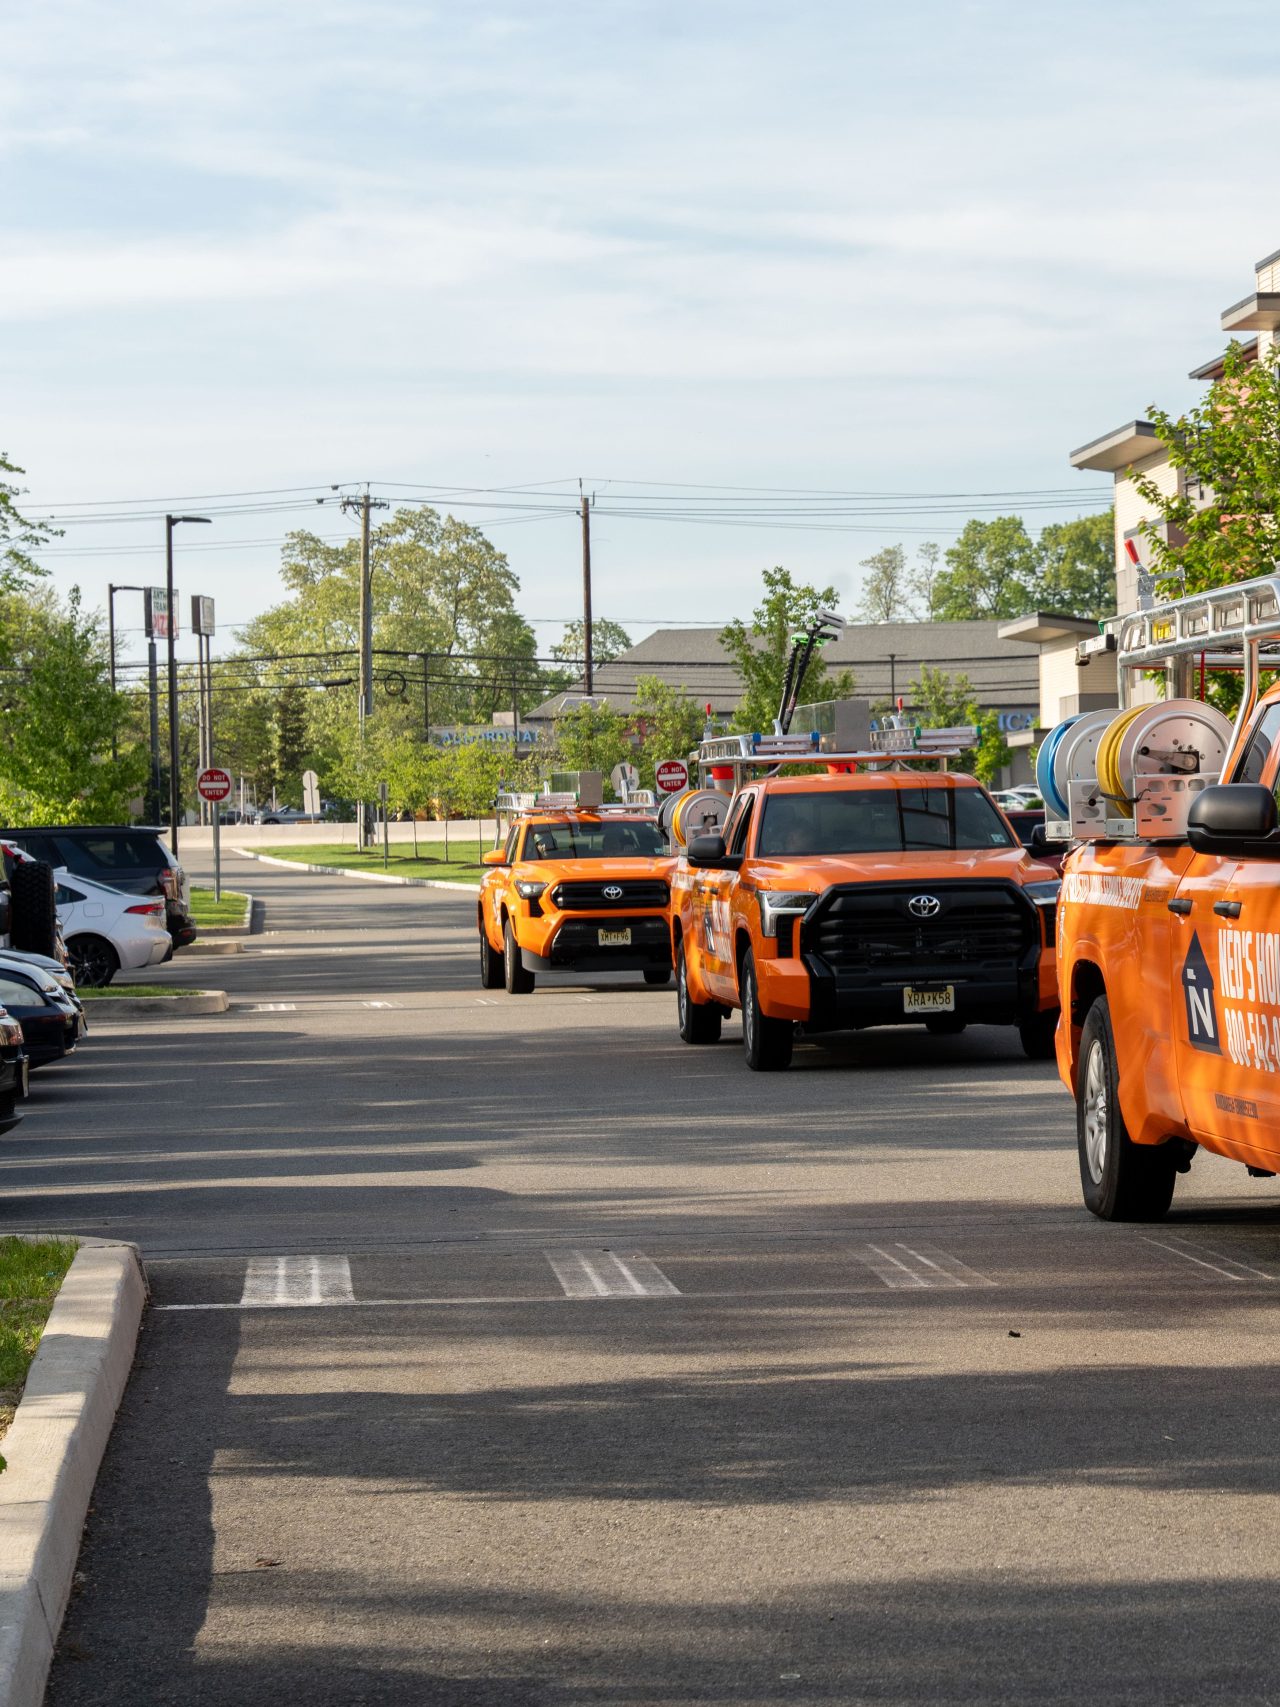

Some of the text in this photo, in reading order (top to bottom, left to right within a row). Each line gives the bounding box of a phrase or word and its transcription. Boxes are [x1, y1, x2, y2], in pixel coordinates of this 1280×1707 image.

[663, 780, 682, 788] ENTER
[1218, 928, 1256, 1002] NED'S
[1188, 985, 1215, 1039] N
